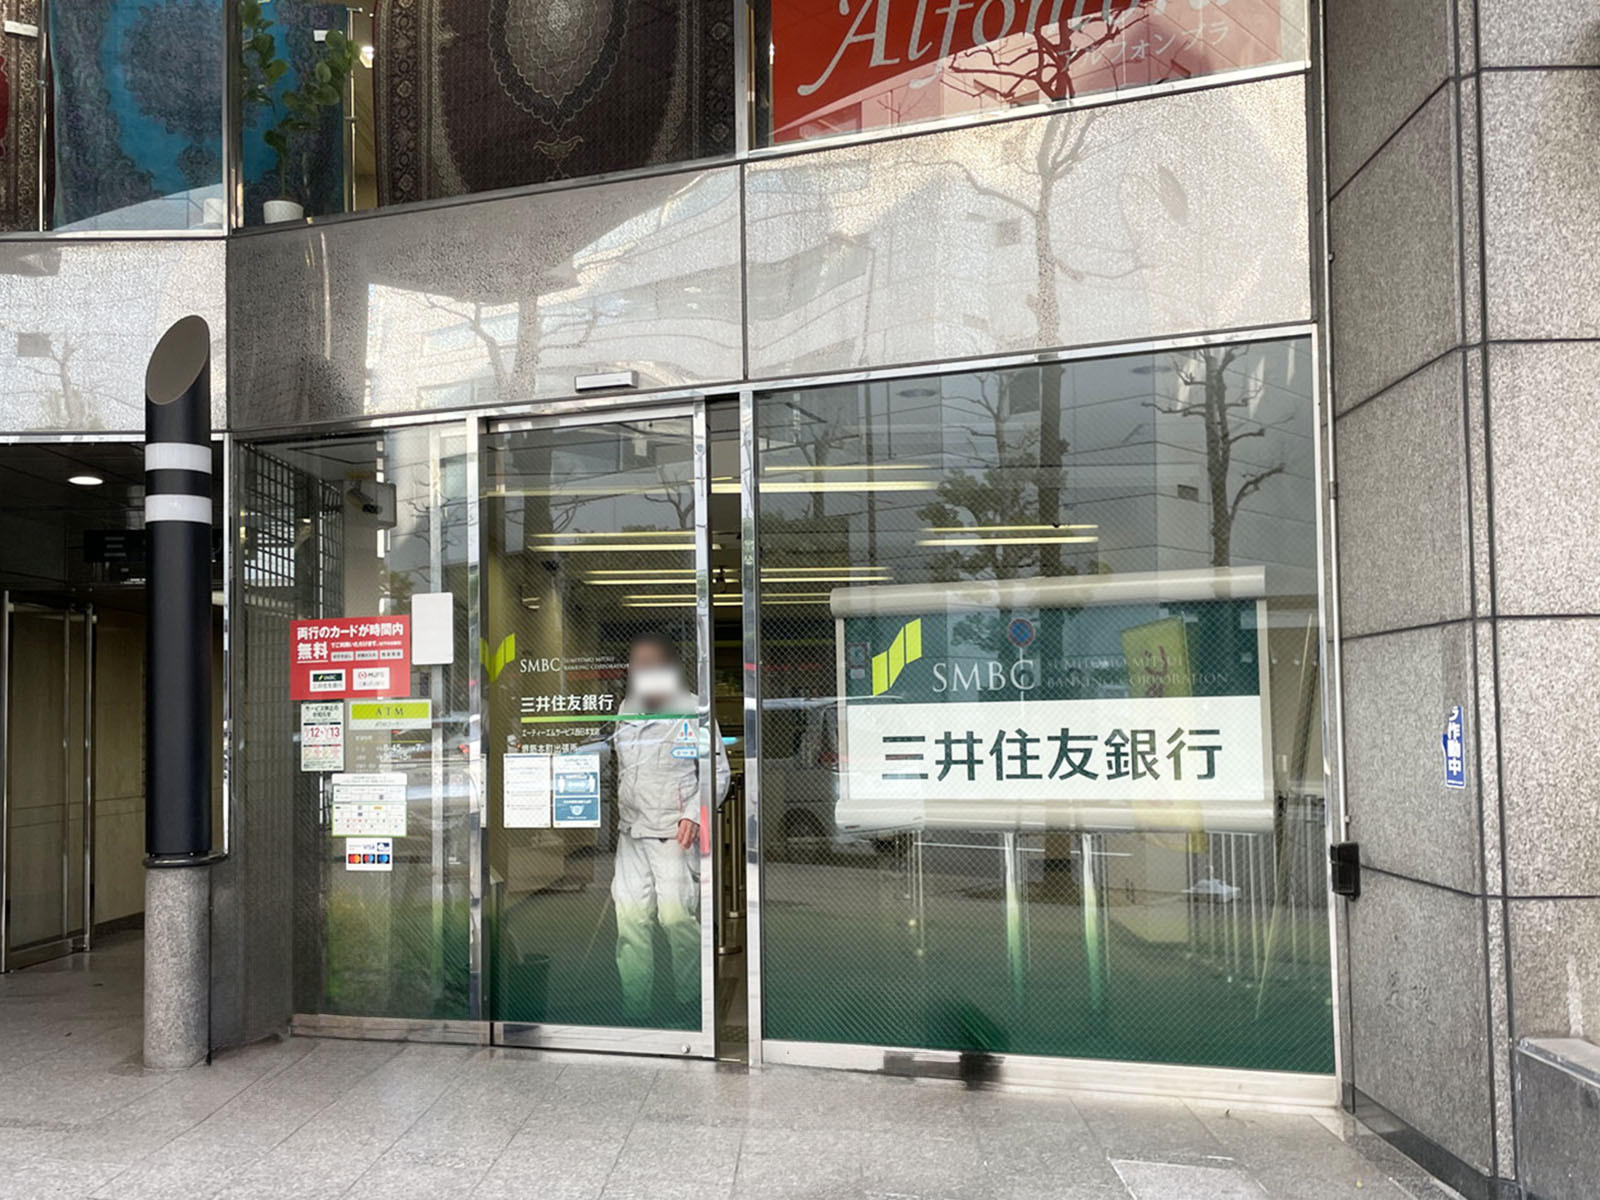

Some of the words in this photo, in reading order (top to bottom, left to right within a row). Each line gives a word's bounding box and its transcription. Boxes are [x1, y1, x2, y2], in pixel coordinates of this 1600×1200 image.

[296, 622, 404, 641] 両行のカードが時間内
[296, 641, 329, 660] 無料
[520, 658, 562, 673] SMBC
[932, 659, 1036, 693] SMBC
[376, 707, 404, 716] ATM
[520, 694, 614, 713] 三井住友銀行
[881, 727, 1223, 782] 三井住友銀行
